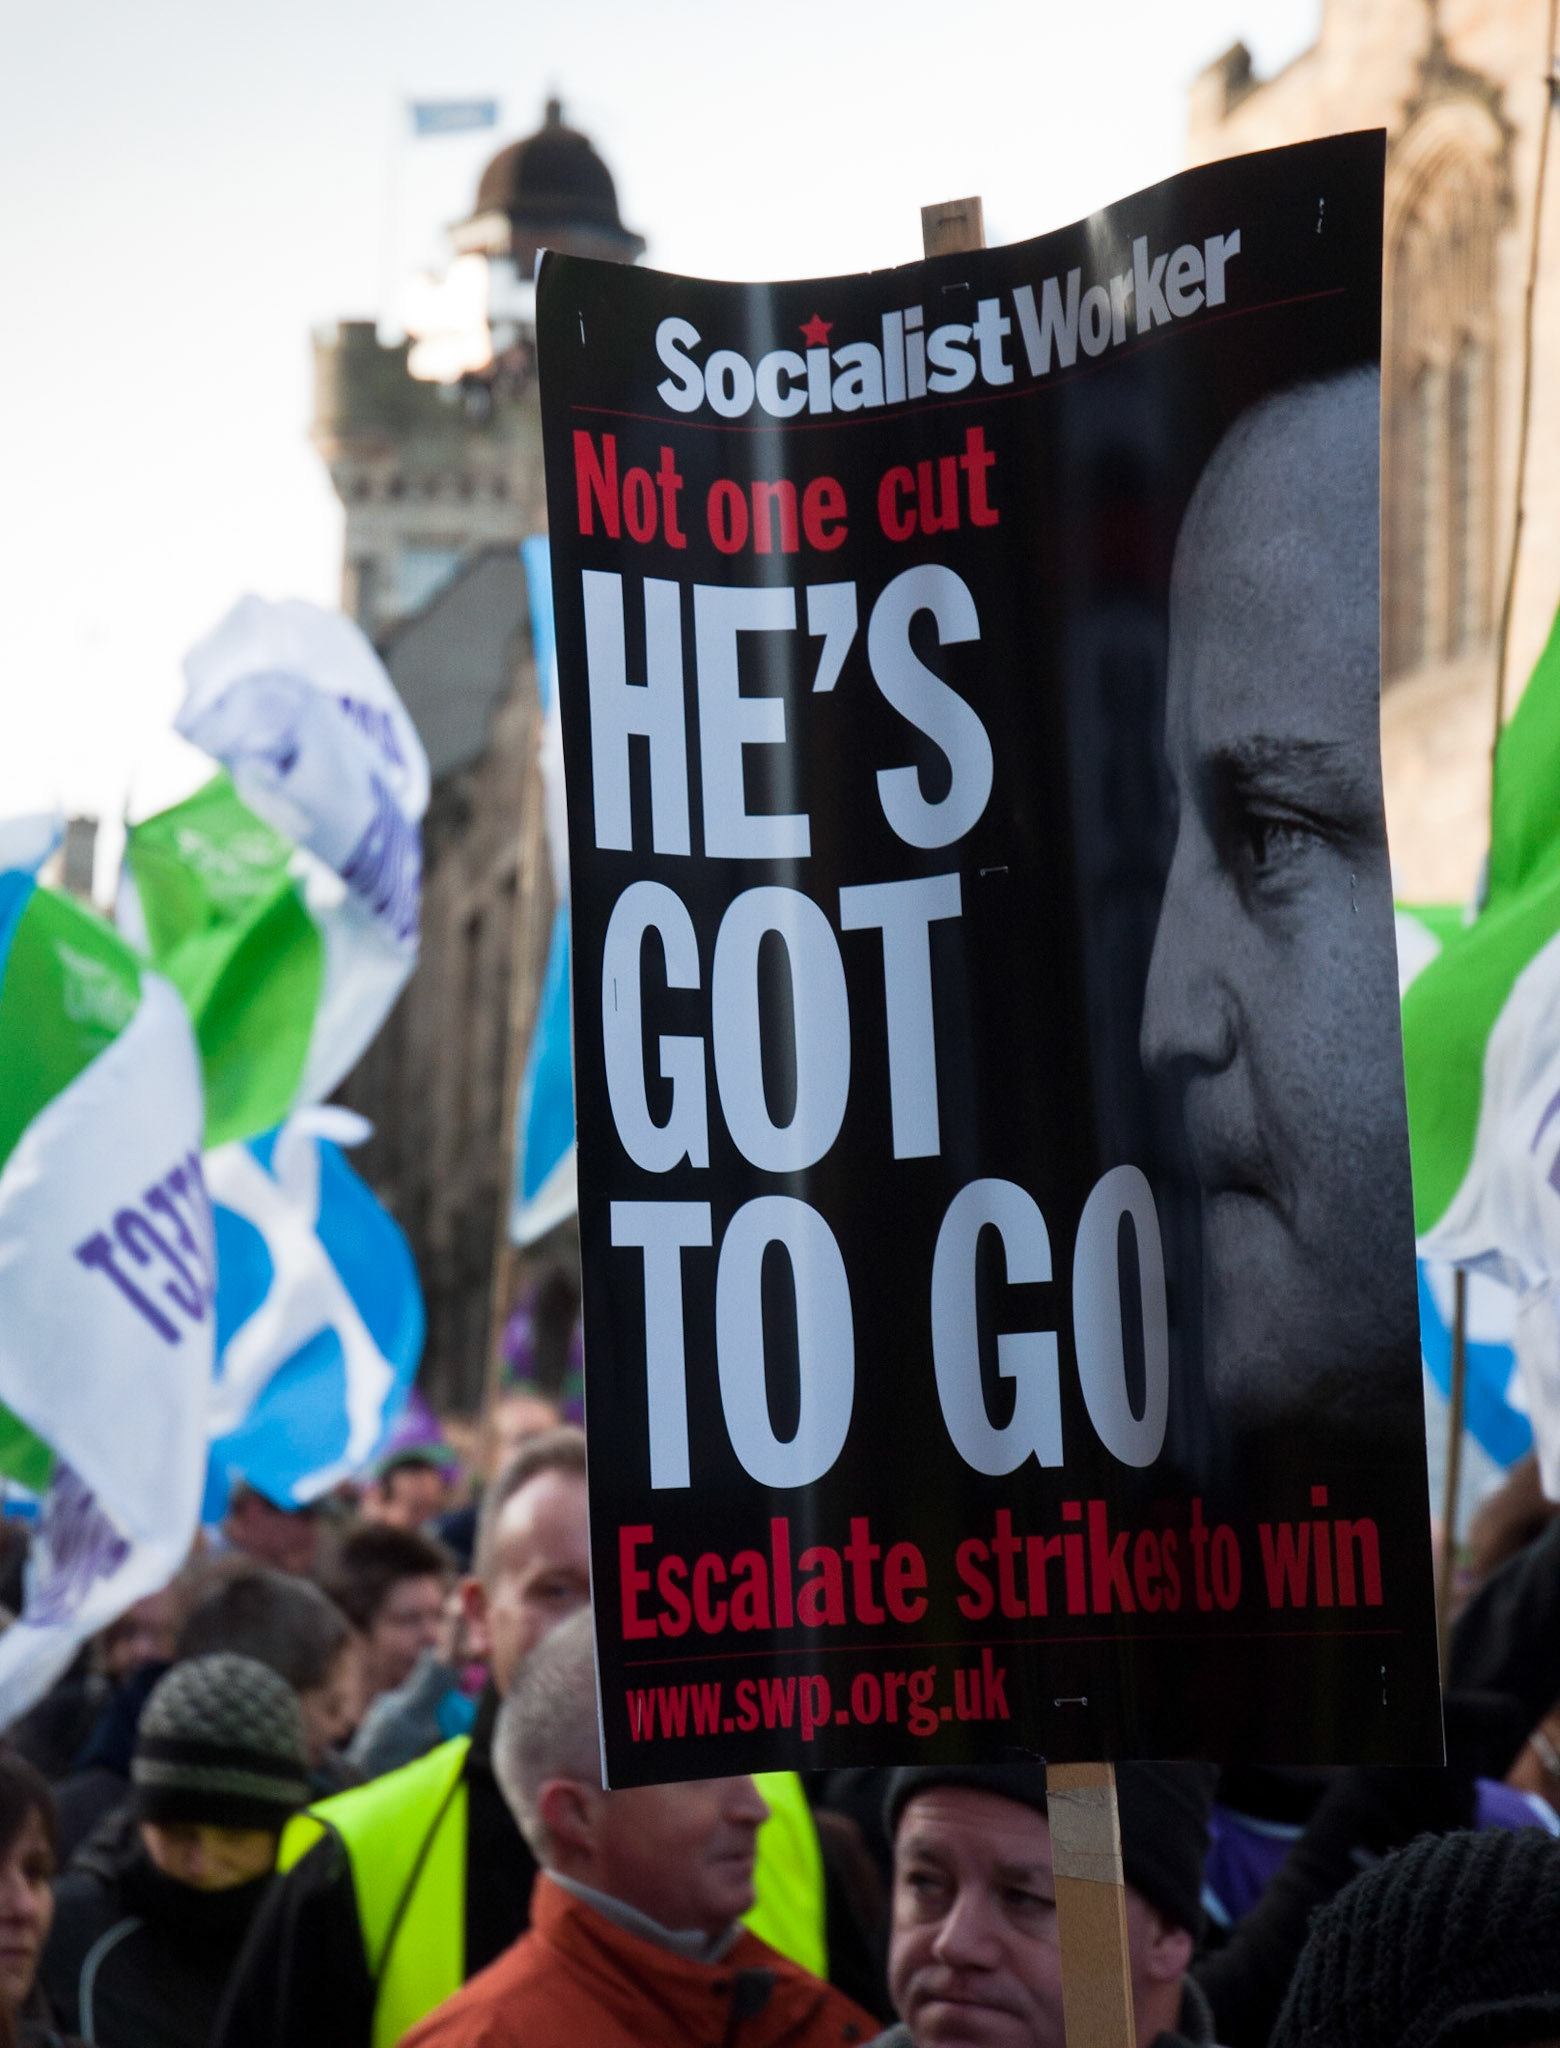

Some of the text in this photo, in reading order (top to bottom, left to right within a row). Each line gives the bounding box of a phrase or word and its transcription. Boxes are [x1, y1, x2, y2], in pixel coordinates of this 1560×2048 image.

[655, 229, 1241, 418] Socialist Worker
[573, 426, 999, 555] Not one cut
[582, 564, 993, 860] HE'S
[602, 872, 963, 1174] GOT
[610, 1163, 1168, 1489] TO GO
[619, 1486, 1383, 1640] Escalate strikes to win
[626, 1648, 1010, 1743] www.swp.org.uk
